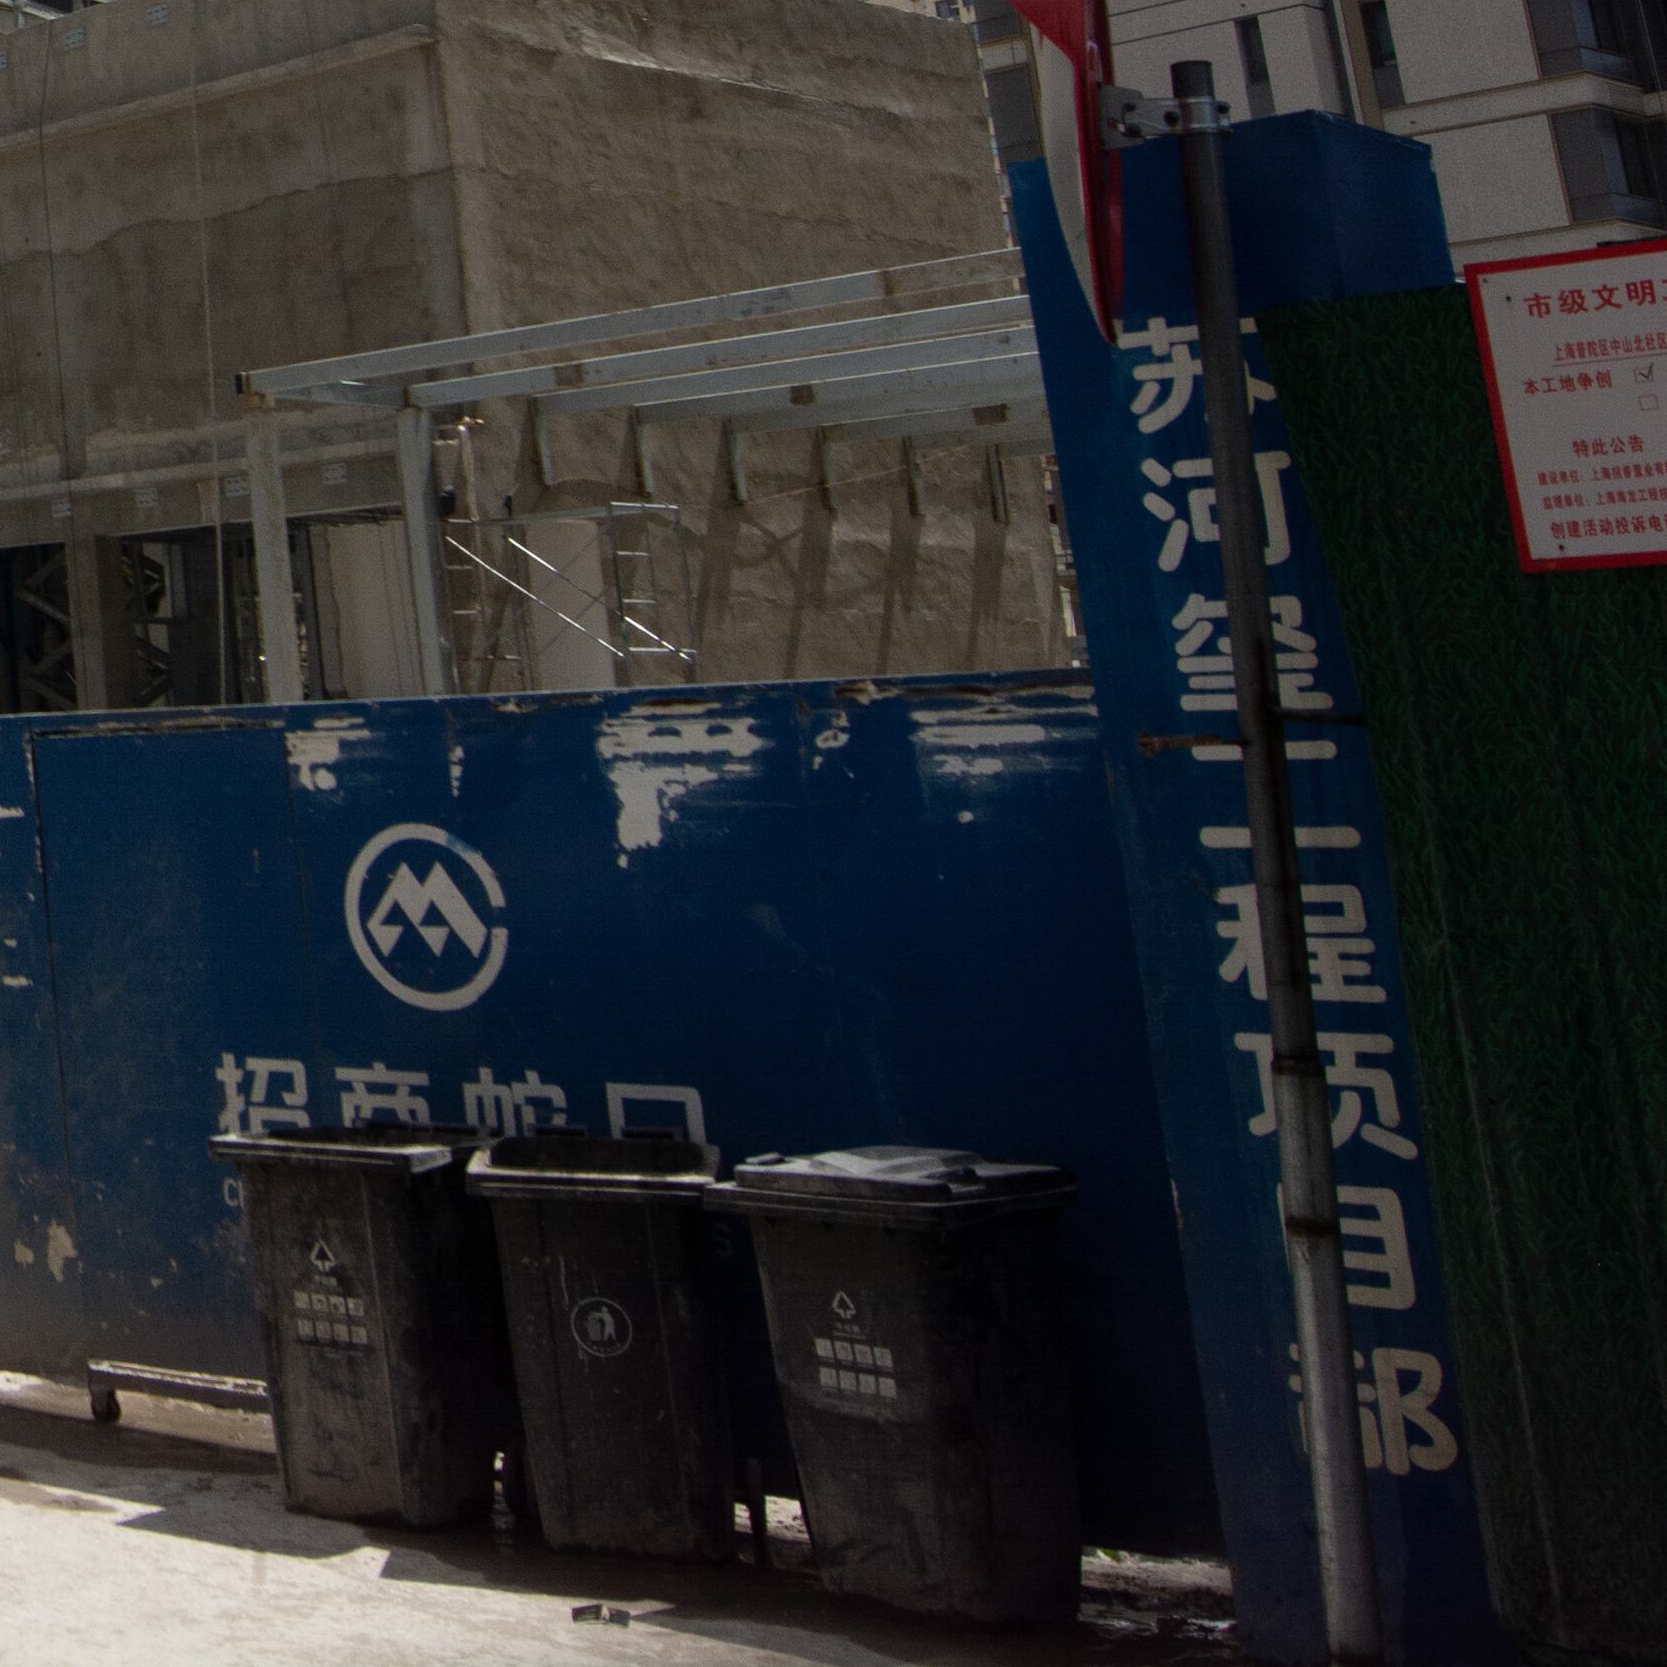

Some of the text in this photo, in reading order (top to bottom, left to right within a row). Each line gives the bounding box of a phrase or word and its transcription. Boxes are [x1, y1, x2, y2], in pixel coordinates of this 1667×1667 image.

[1523, 279, 1667, 319] 市级文明
[1523, 369, 1613, 395] 本工地争创
[1572, 434, 1644, 457] 特此公告
[1550, 513, 1667, 540] 创建活动投诉电
[215, 1052, 707, 1146] 招商蛇口
